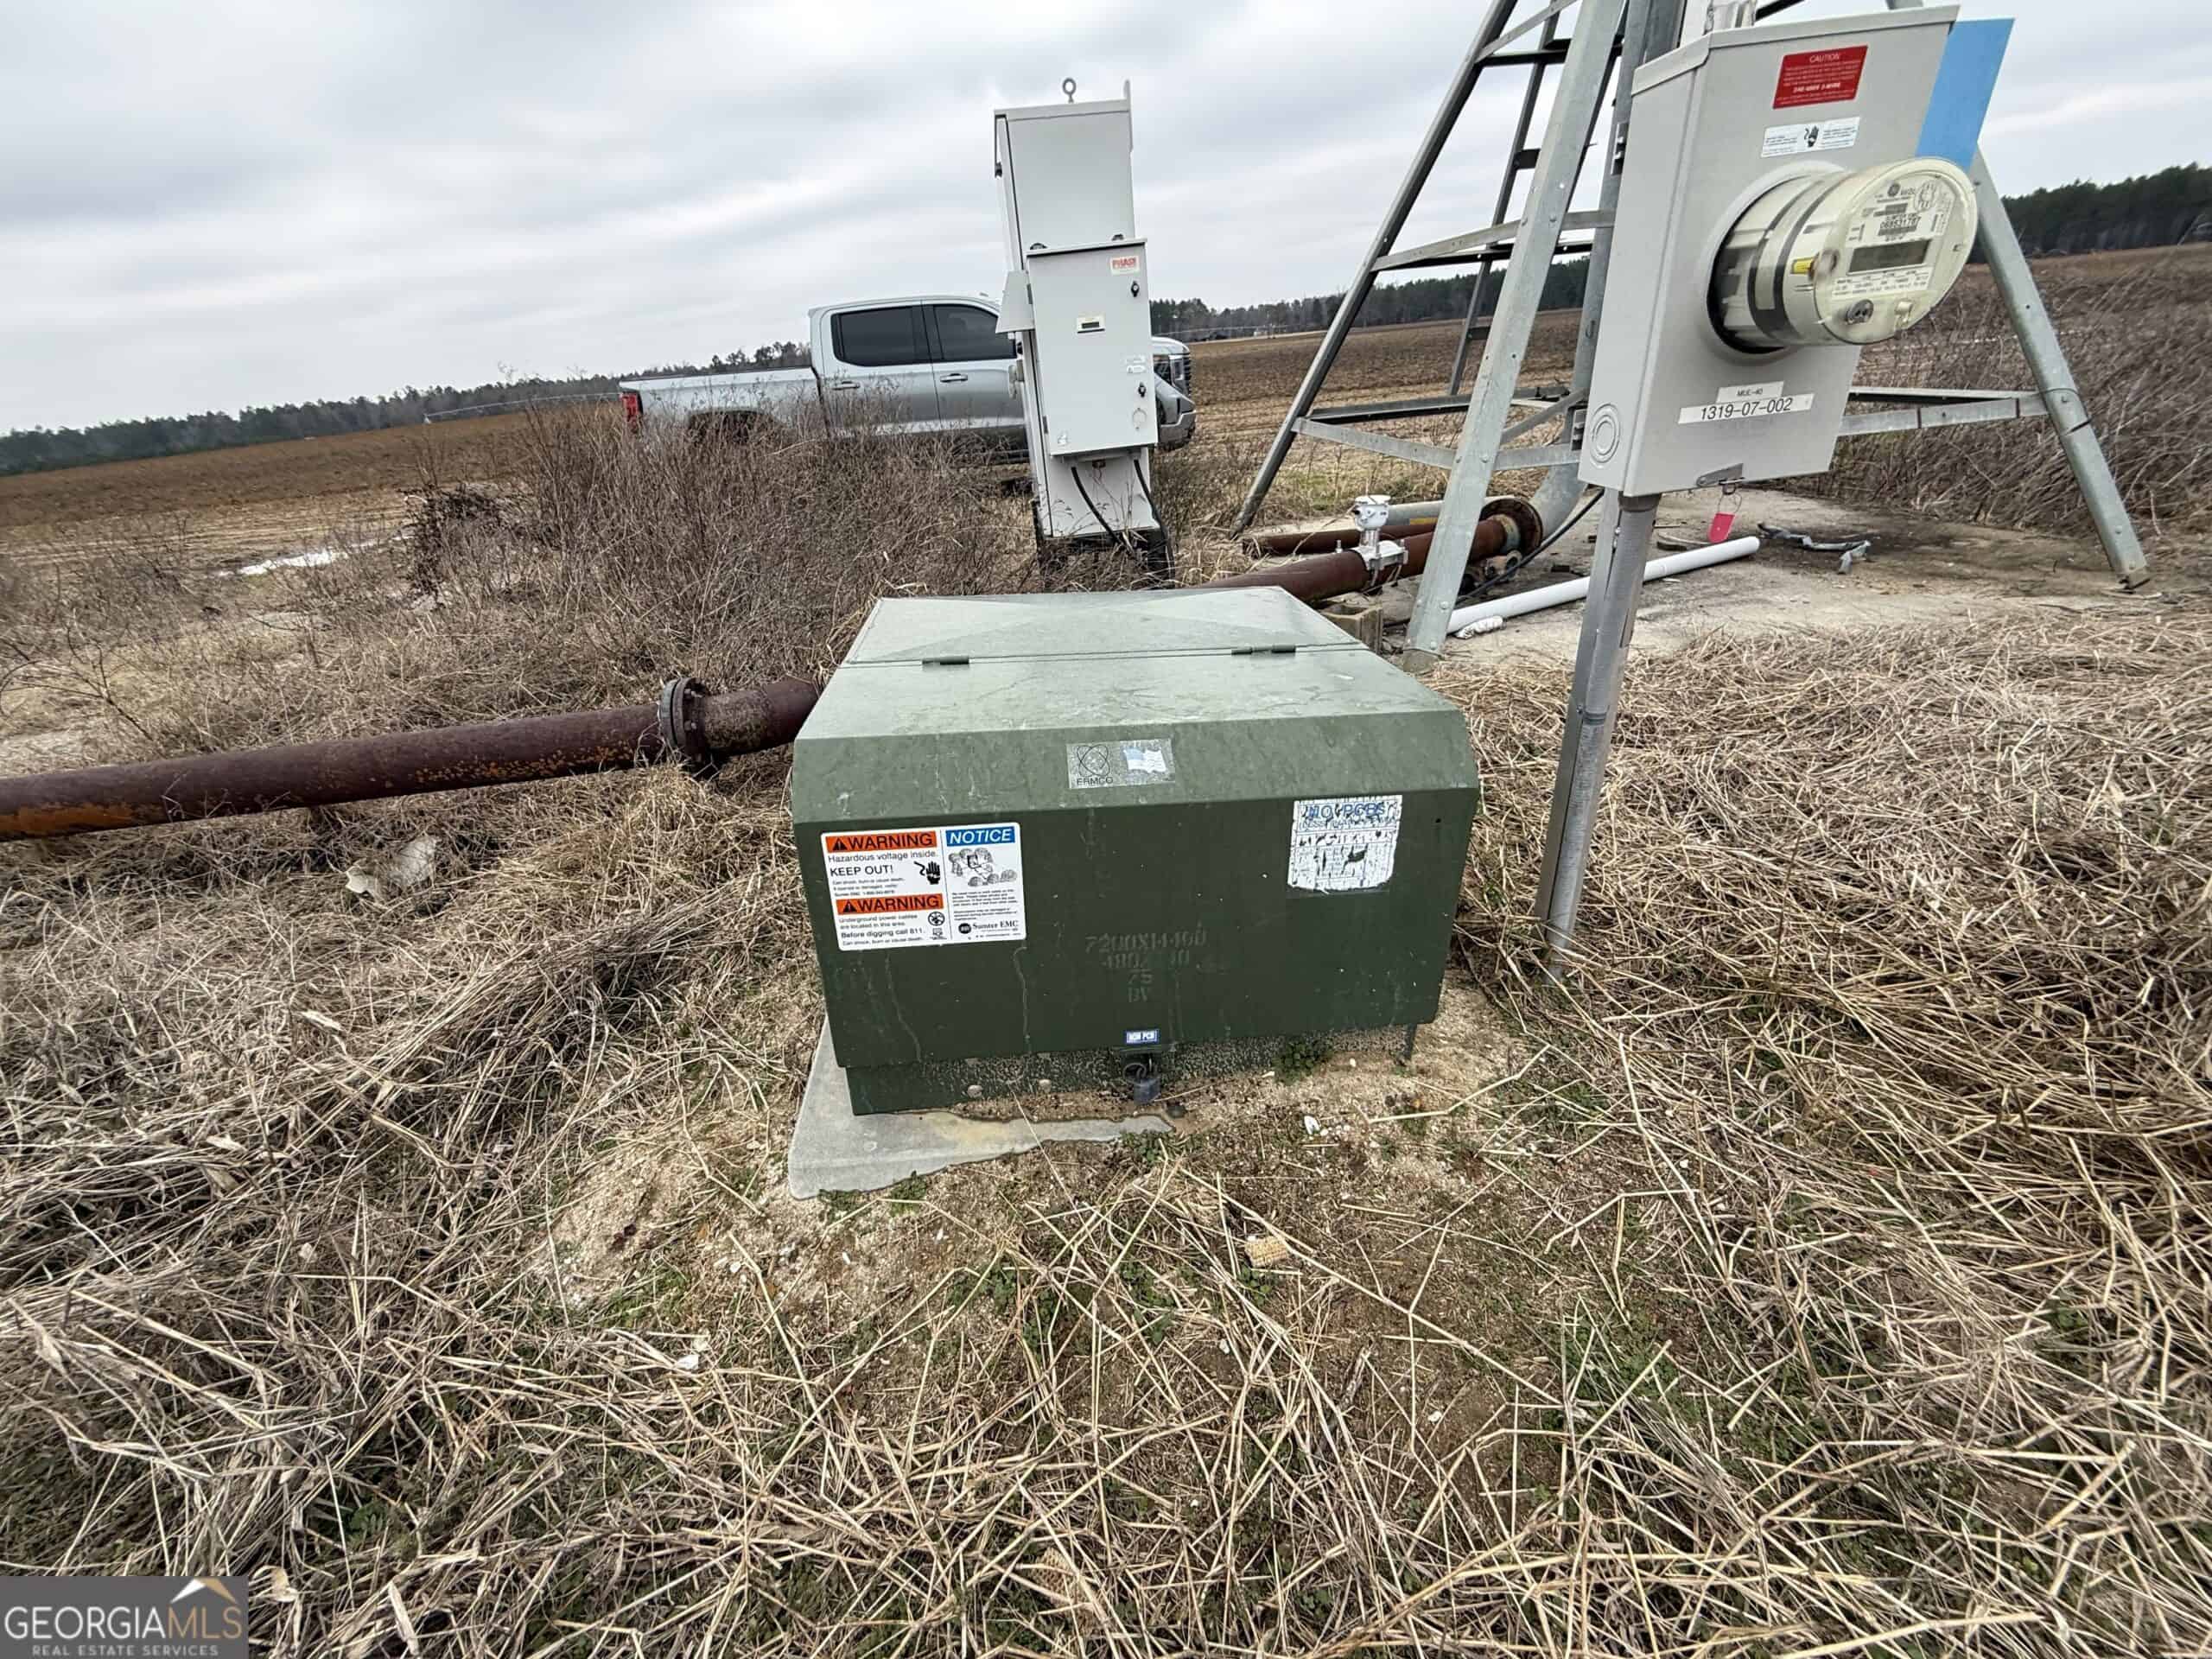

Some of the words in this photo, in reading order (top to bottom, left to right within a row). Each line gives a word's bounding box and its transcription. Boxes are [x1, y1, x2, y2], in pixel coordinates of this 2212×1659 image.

[1809, 53, 1840, 63] CAUTION
[1700, 397, 1793, 420] 1319-07-002
[1077, 776, 1114, 785] ERMCO
[847, 832, 933, 849] WARNING
[950, 829, 1013, 845] NOTICE
[828, 854, 874, 863] Hazardous
[877, 851, 908, 861] voltage
[830, 866, 861, 877] KEEP
[864, 864, 893, 875] OUT!
[857, 895, 939, 912] WARNING
[1000, 919, 1019, 928] EMC
